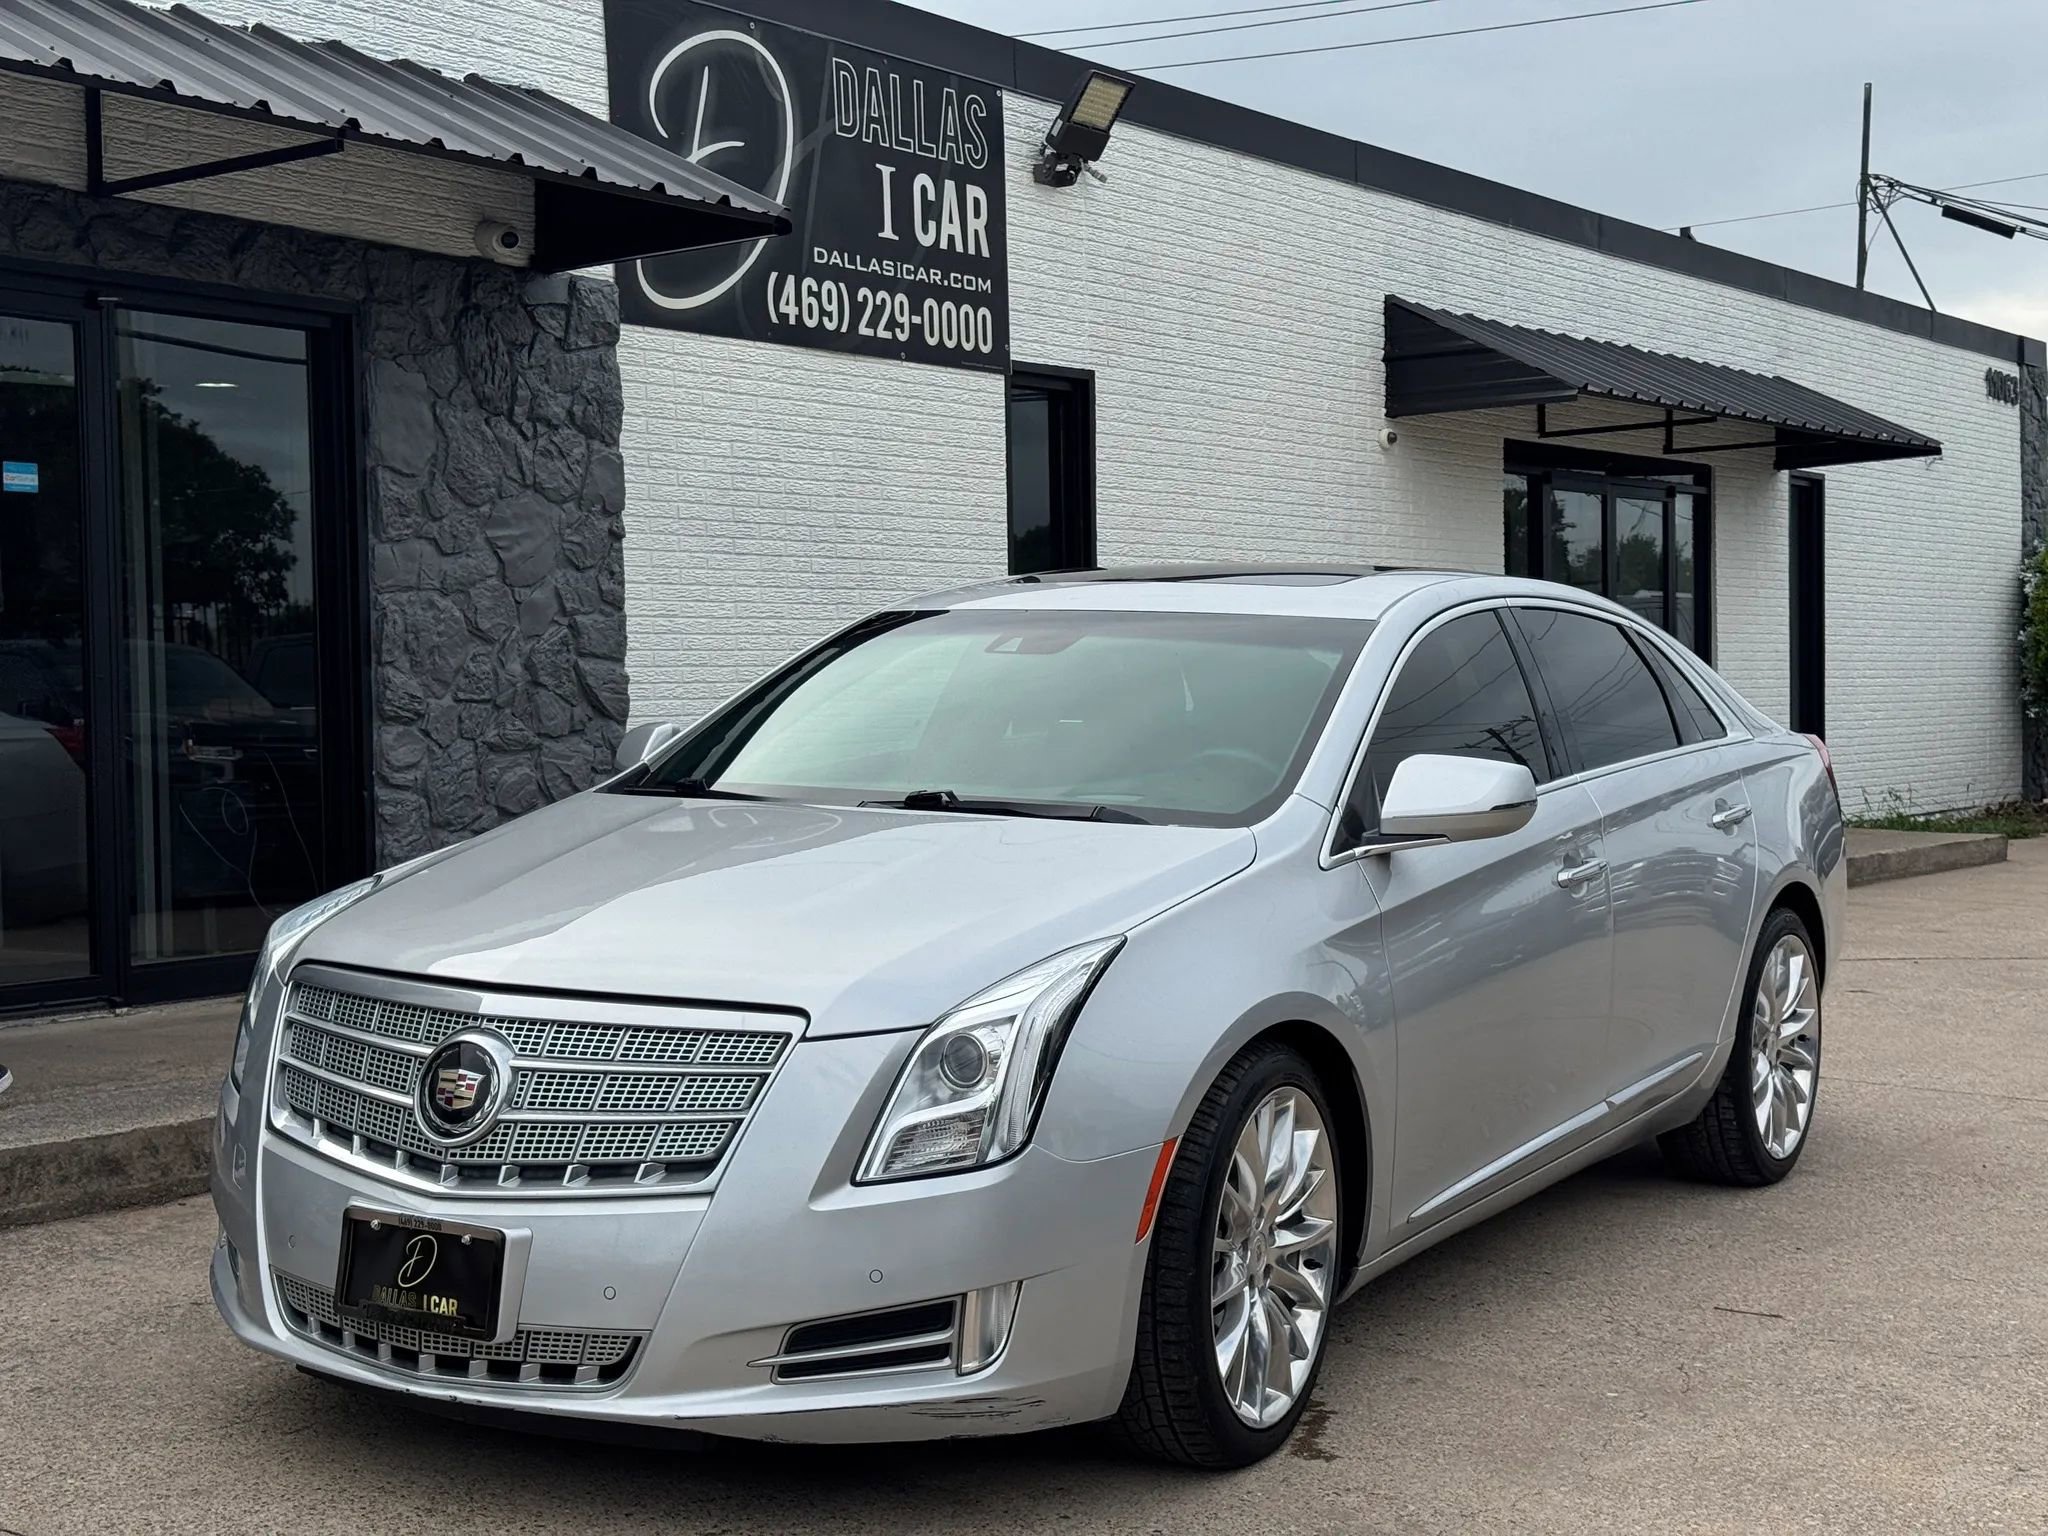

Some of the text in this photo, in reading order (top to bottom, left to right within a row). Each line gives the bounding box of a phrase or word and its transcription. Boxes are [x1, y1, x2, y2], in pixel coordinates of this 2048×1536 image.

[832, 57, 988, 170] DALLAS
[875, 163, 991, 258] I CAR
[813, 246, 992, 294] DALLASICAR.COM
[767, 271, 993, 354] (469) 229-0000
[372, 1285, 458, 1316] DALLAS I CAR
